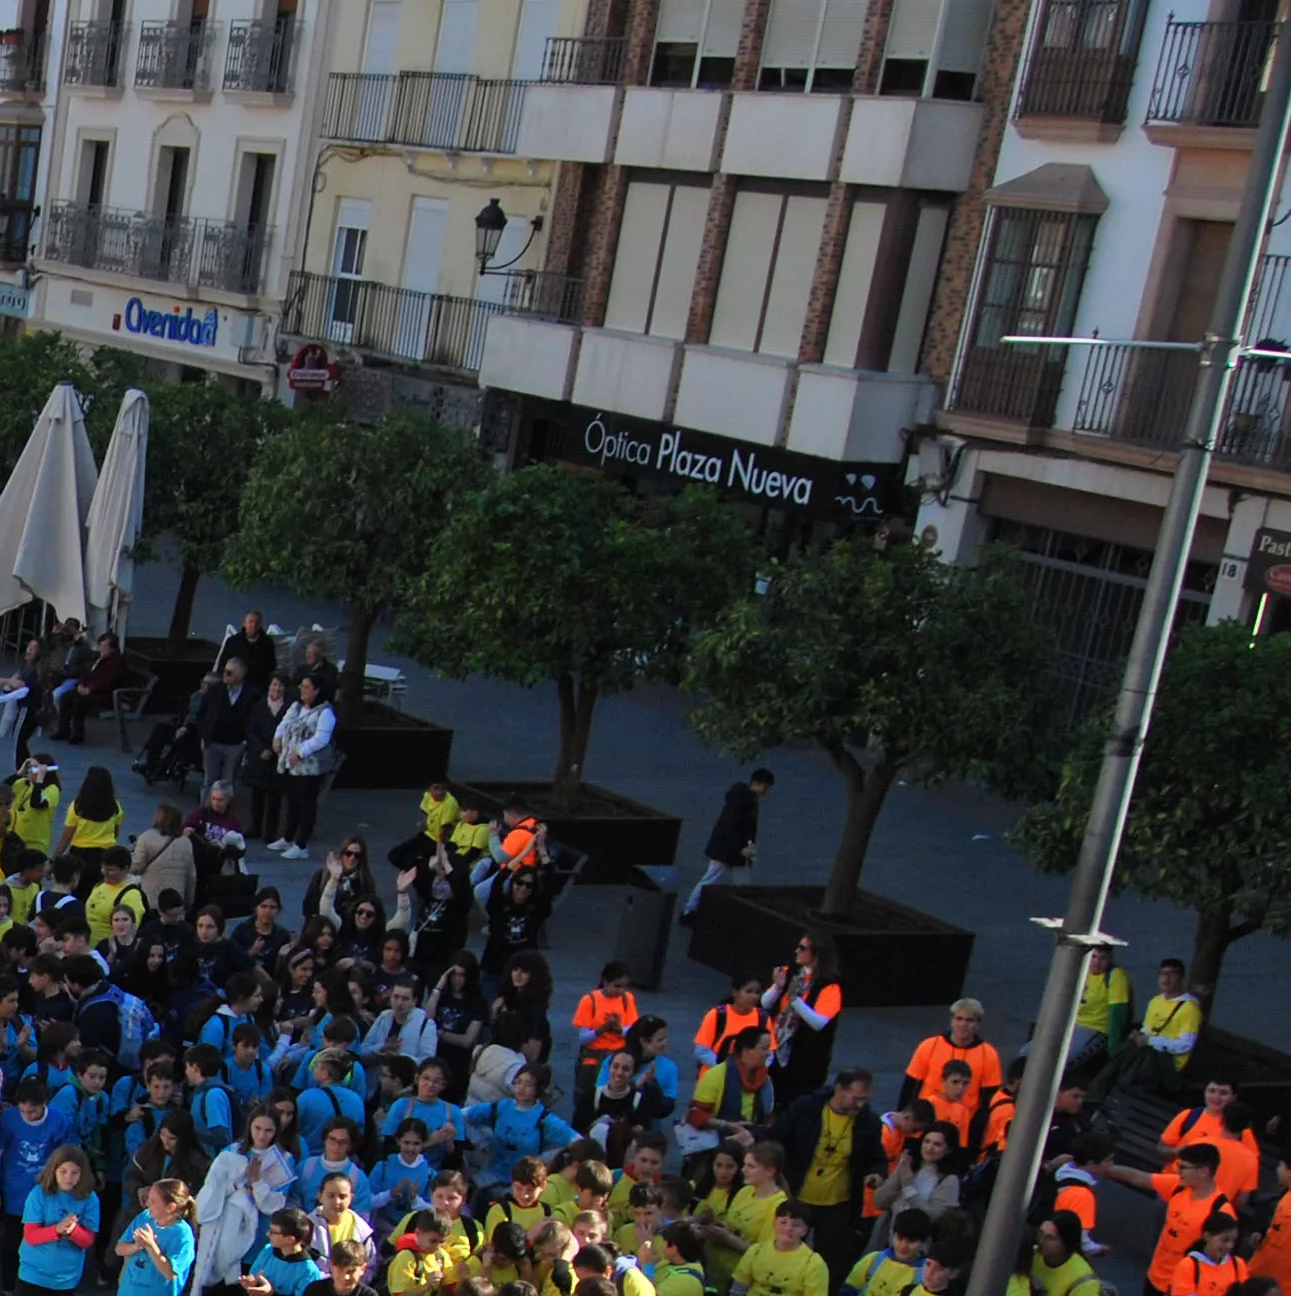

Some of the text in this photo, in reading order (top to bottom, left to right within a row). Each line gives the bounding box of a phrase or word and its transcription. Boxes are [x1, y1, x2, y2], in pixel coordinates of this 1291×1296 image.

[585, 413, 813, 505] Óptica Plaza Nueva
[1259, 535, 1291, 558] Past
[1221, 562, 1237, 578] 18
